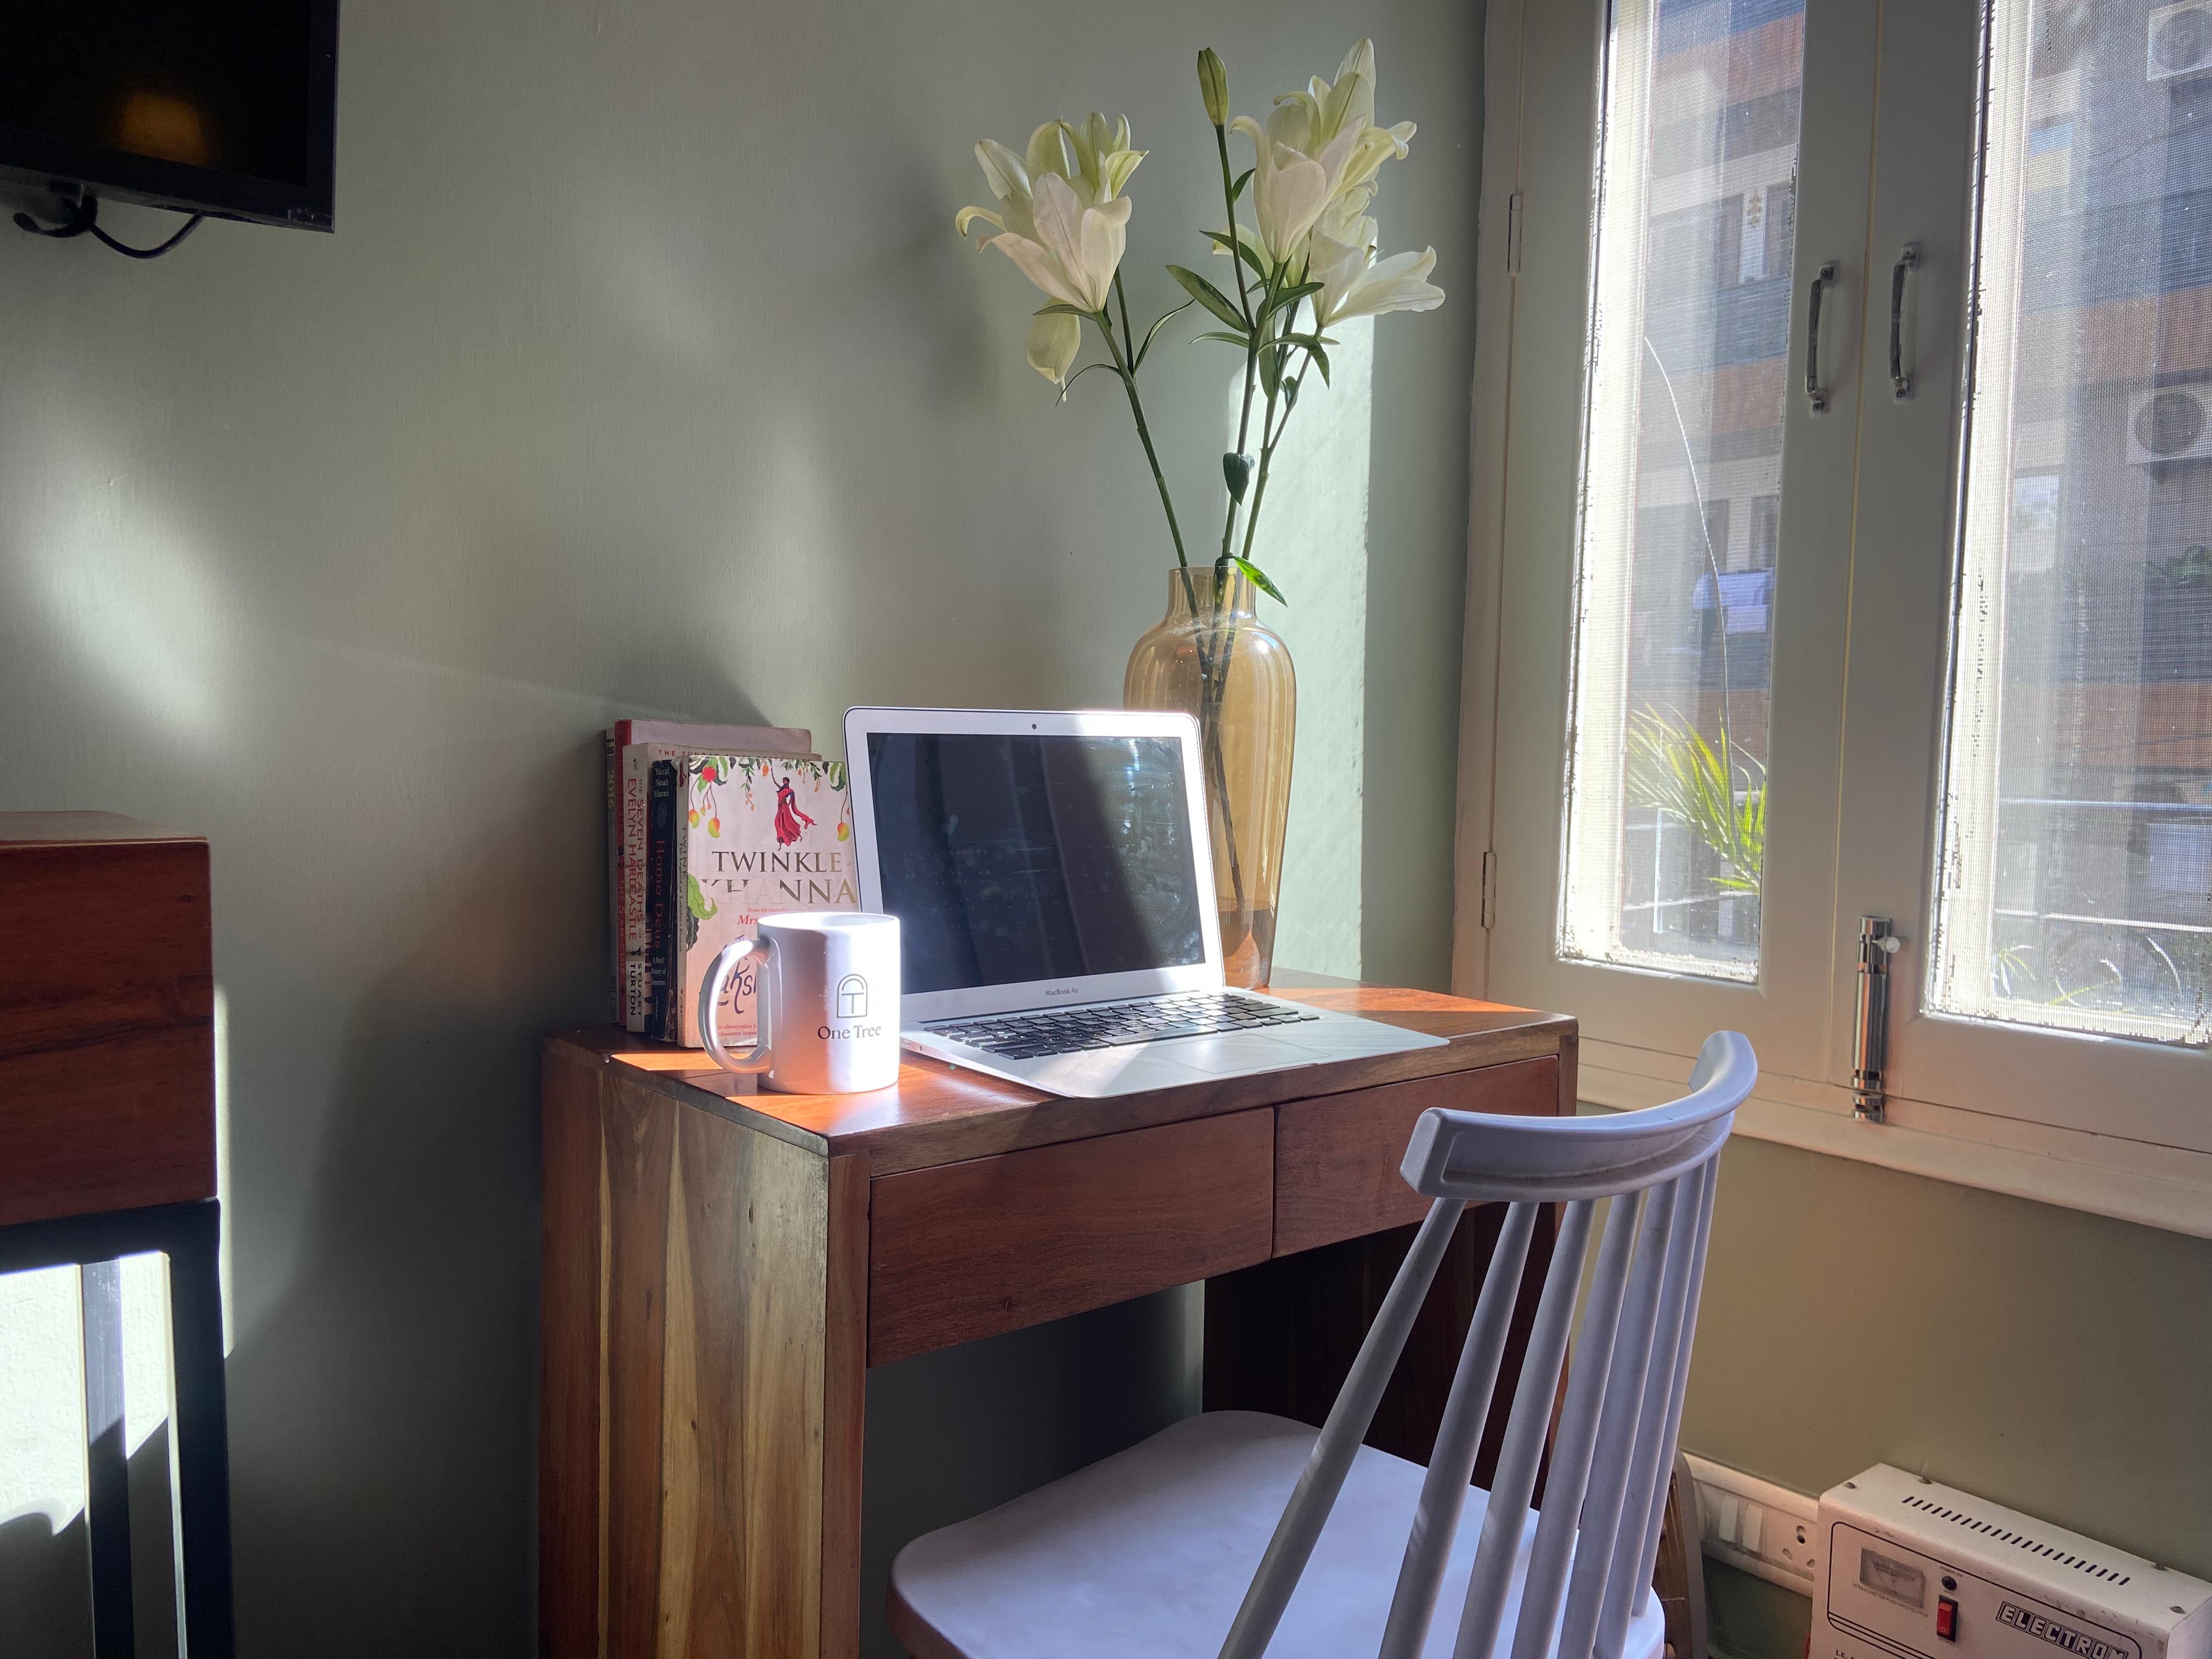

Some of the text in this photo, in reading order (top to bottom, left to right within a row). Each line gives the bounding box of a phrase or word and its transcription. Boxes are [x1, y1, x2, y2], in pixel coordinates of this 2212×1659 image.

[654, 766, 670, 776] Yuval
[655, 778, 669, 787] Noah
[628, 778, 637, 940] EVELYN HARDCASTLE
[712, 851, 843, 873] TWINKLE
[655, 839, 665, 949] Homo Deus
[701, 878, 858, 905] KHANNA
[618, 905, 625, 914] 5
[737, 915, 758, 926] Mrs
[619, 918, 624, 939] AM
[1045, 988, 1070, 997] MacBook
[817, 1025, 882, 1040] One Tree
